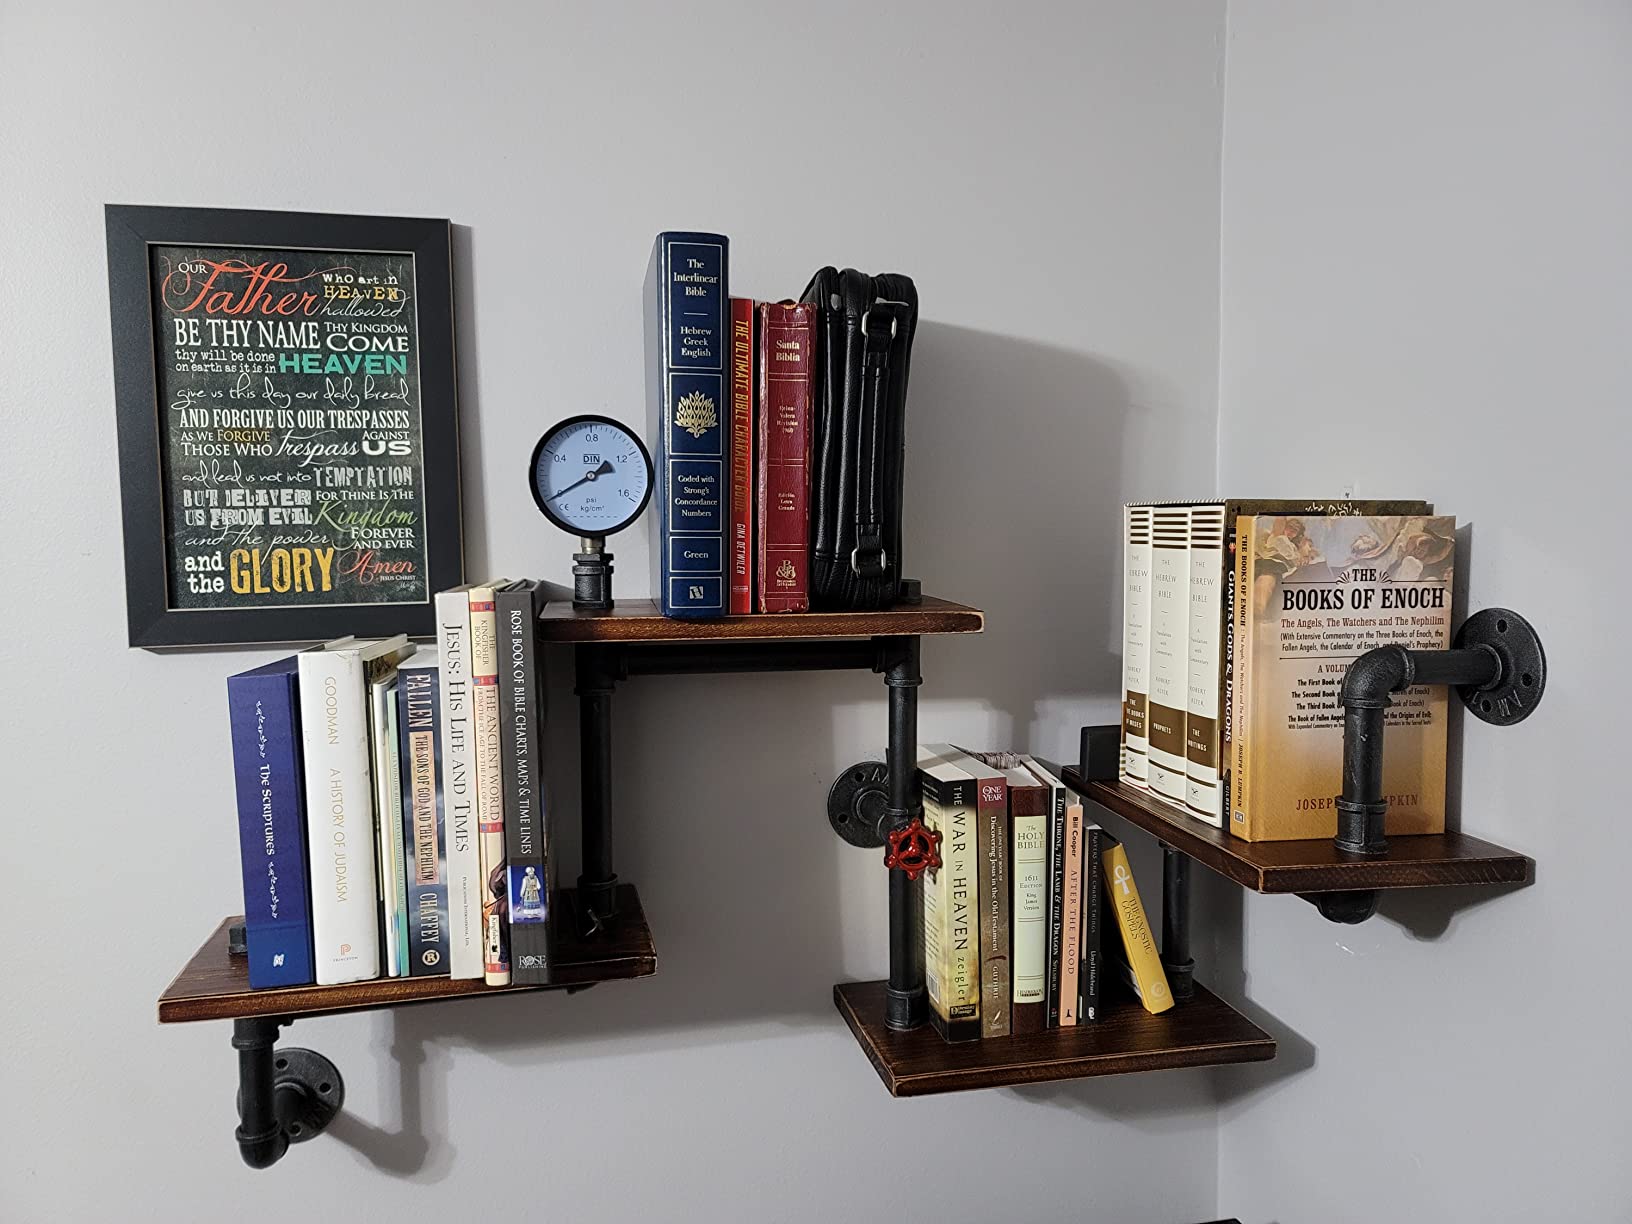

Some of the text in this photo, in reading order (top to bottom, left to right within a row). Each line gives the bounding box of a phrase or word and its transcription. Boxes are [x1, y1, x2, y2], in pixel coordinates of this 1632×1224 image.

[687, 259, 704, 269] The
[162, 256, 351, 317] Father
[674, 272, 718, 284] Interlinear
[685, 287, 706, 297] Bible
[320, 290, 411, 317] hallowed
[174, 318, 320, 348] BE THY NAME
[680, 327, 712, 335] Hebrew
[326, 334, 409, 352] COME
[684, 338, 708, 346] Greek
[776, 340, 800, 350] Santa
[175, 350, 275, 362] thy will be done
[681, 348, 711, 358] English
[776, 352, 800, 361] Biblia
[176, 362, 276, 373] on earth as in
[279, 354, 407, 374] HEAVEN
[171, 372, 411, 410] give us this day our daily bread
[180, 409, 409, 429] AND FORGIVE US OUR TRESPASSES
[735, 320, 749, 512] THE ULTIMATE BIBLE CHARACTER GUIDE
[275, 430, 360, 468] Trespass
[362, 441, 412, 456] US
[313, 466, 412, 487] TEMPTATION
[678, 475, 714, 483] Coded with
[184, 489, 311, 507] BUT DELIVER
[684, 486, 709, 495] Strong's
[675, 498, 717, 506] Concordance
[185, 508, 313, 525] US FROM EVIL
[312, 493, 418, 549] Kingdom
[682, 509, 711, 517] Numbers
[736, 523, 746, 538] GINA
[185, 552, 224, 571] and
[684, 551, 708, 559] Green
[736, 540, 746, 574] DETWILER
[230, 547, 335, 594] GLORY
[337, 550, 416, 584] Amen
[1352, 568, 1377, 582] THE
[188, 574, 224, 593] the
[1283, 588, 1445, 610] BOOKS OF ENOCH
[1281, 619, 1295, 628] The
[1297, 618, 1324, 629] Angels,
[1327, 618, 1340, 627] The
[1342, 617, 1376, 627] Watchers
[1379, 618, 1392, 626] and
[1411, 616, 1444, 627] Nephilim
[1227, 624, 1235, 658] GODS
[1281, 632, 1294, 641] (With
[1296, 632, 1321, 640] Extensive
[1322, 632, 1356, 641] Commentary
[1417, 630, 1433, 638] Enoch,
[1282, 643, 1298, 651] Fallen
[1300, 643, 1318, 652] Angels,
[1330, 642, 1353, 650] Calendar
[406, 674, 433, 727] FALLEN
[324, 676, 340, 745] GOODMAN
[510, 610, 533, 854] ROSE BOOK OF BIBLE CHARTS, MAPS TIME LINES
[1153, 723, 1171, 734] PROPHETS
[486, 687, 500, 820] THE ANCIENT WORLD
[415, 734, 434, 881] THE SONS OF GOD AND THE NEPHILIM
[953, 786, 965, 871] THE WAR IN
[988, 816, 997, 858] Discovering
[1018, 832, 1044, 840] HOLY
[331, 780, 348, 902] HISTORY OF JUDAISM
[1070, 830, 1078, 857] Cooper
[1070, 870, 1078, 905] AFTER
[420, 892, 440, 943] CHAFFEY
[954, 878, 968, 950] HEAVEN
[1069, 910, 1077, 932] THE
[519, 955, 546, 965] ROSE
[955, 957, 968, 1000] zeigler
